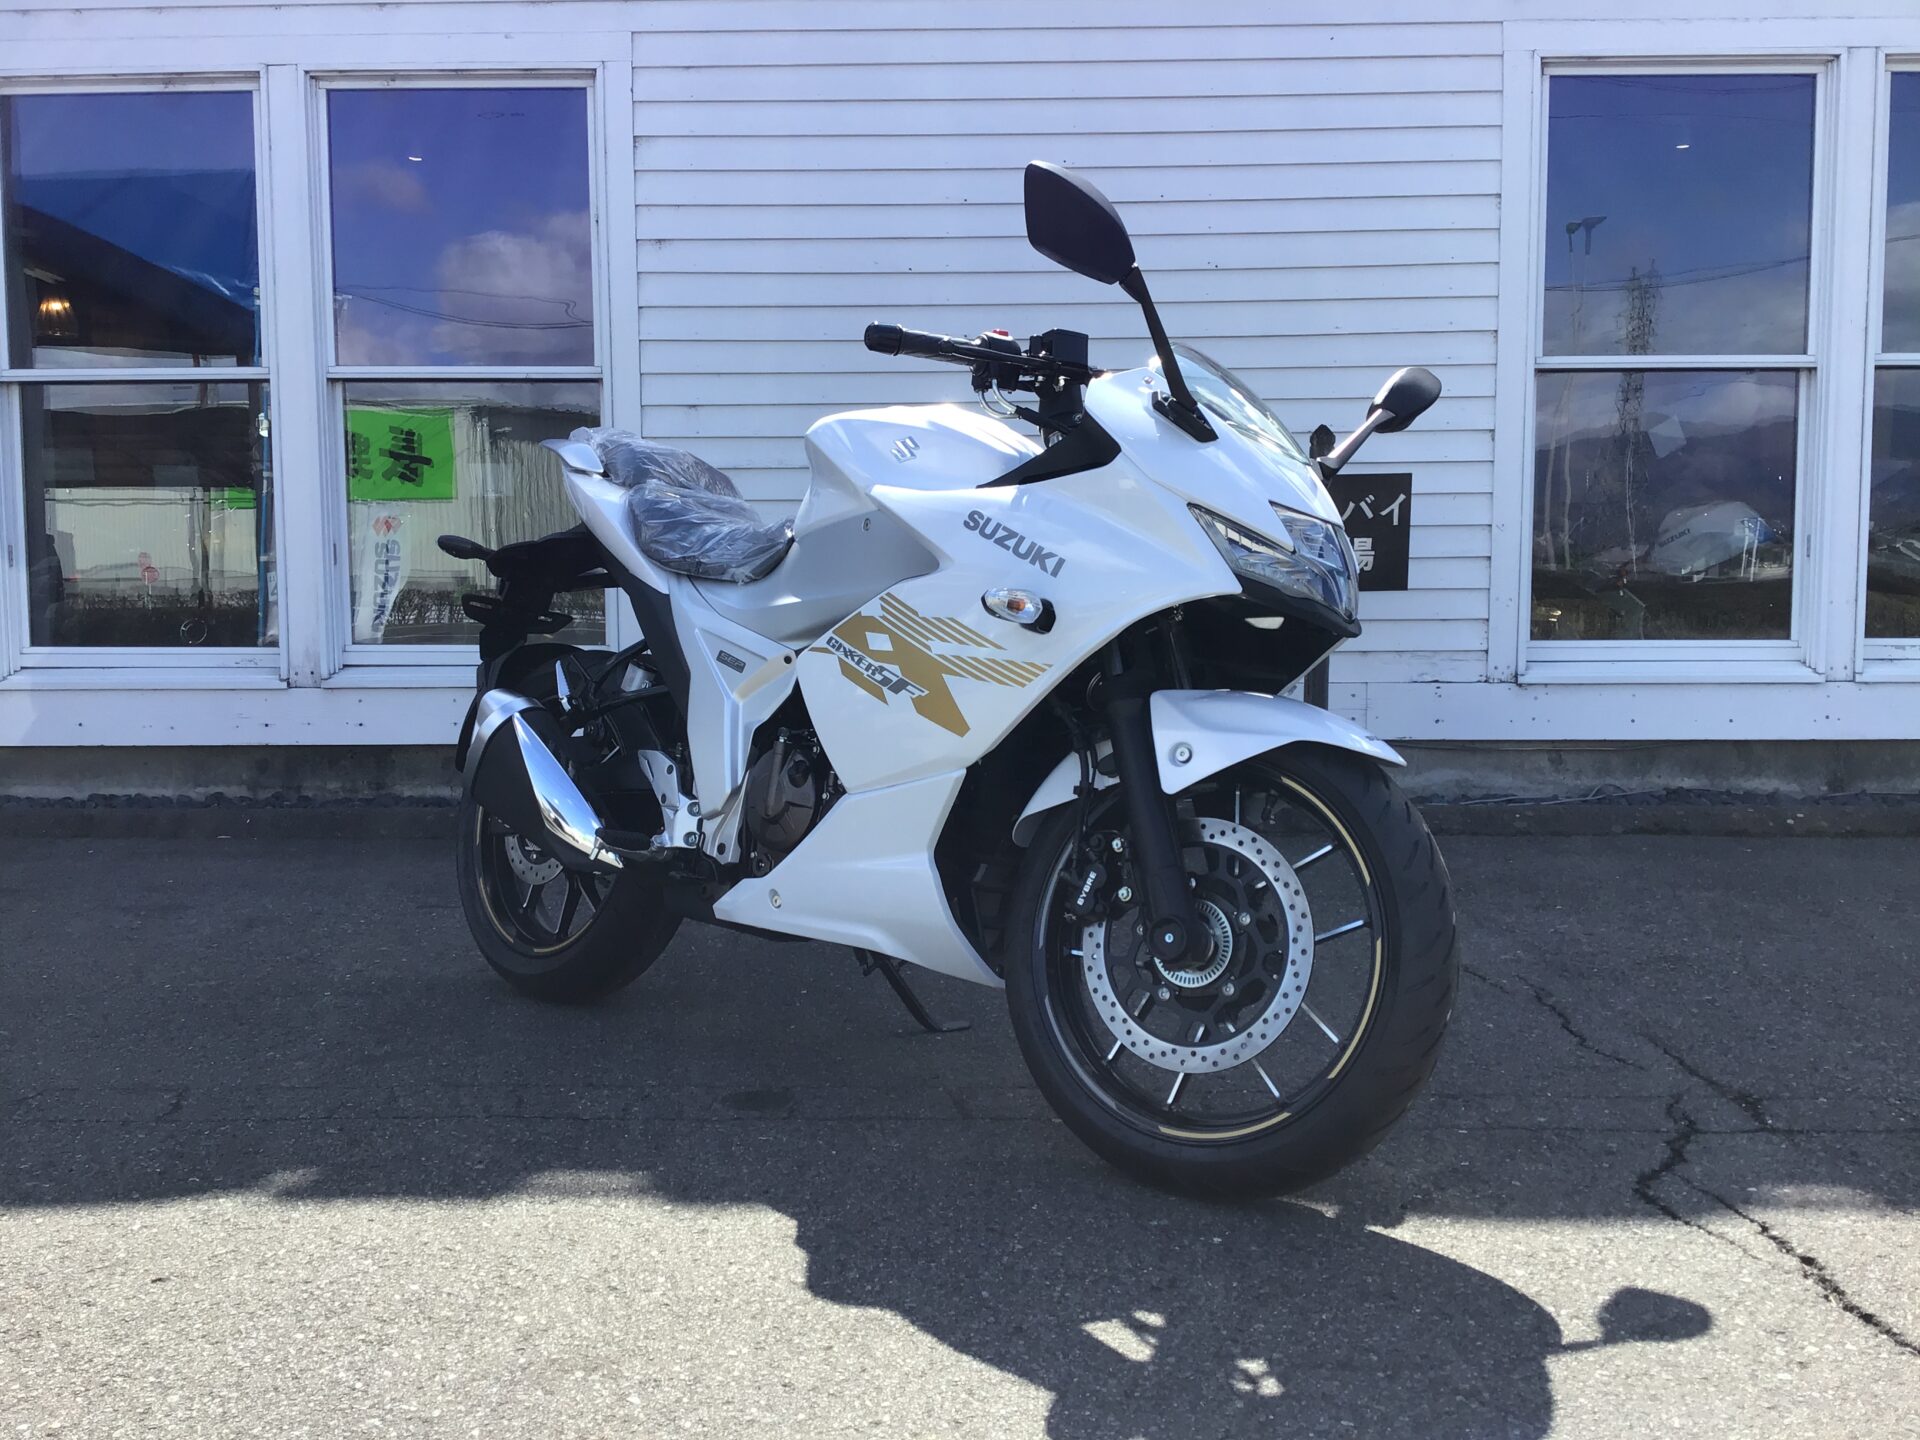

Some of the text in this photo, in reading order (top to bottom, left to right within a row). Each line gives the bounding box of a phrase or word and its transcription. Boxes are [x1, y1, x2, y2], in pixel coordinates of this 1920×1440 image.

[963, 509, 1066, 578] SUZUKI
[826, 636, 925, 695] GIXXER SF
